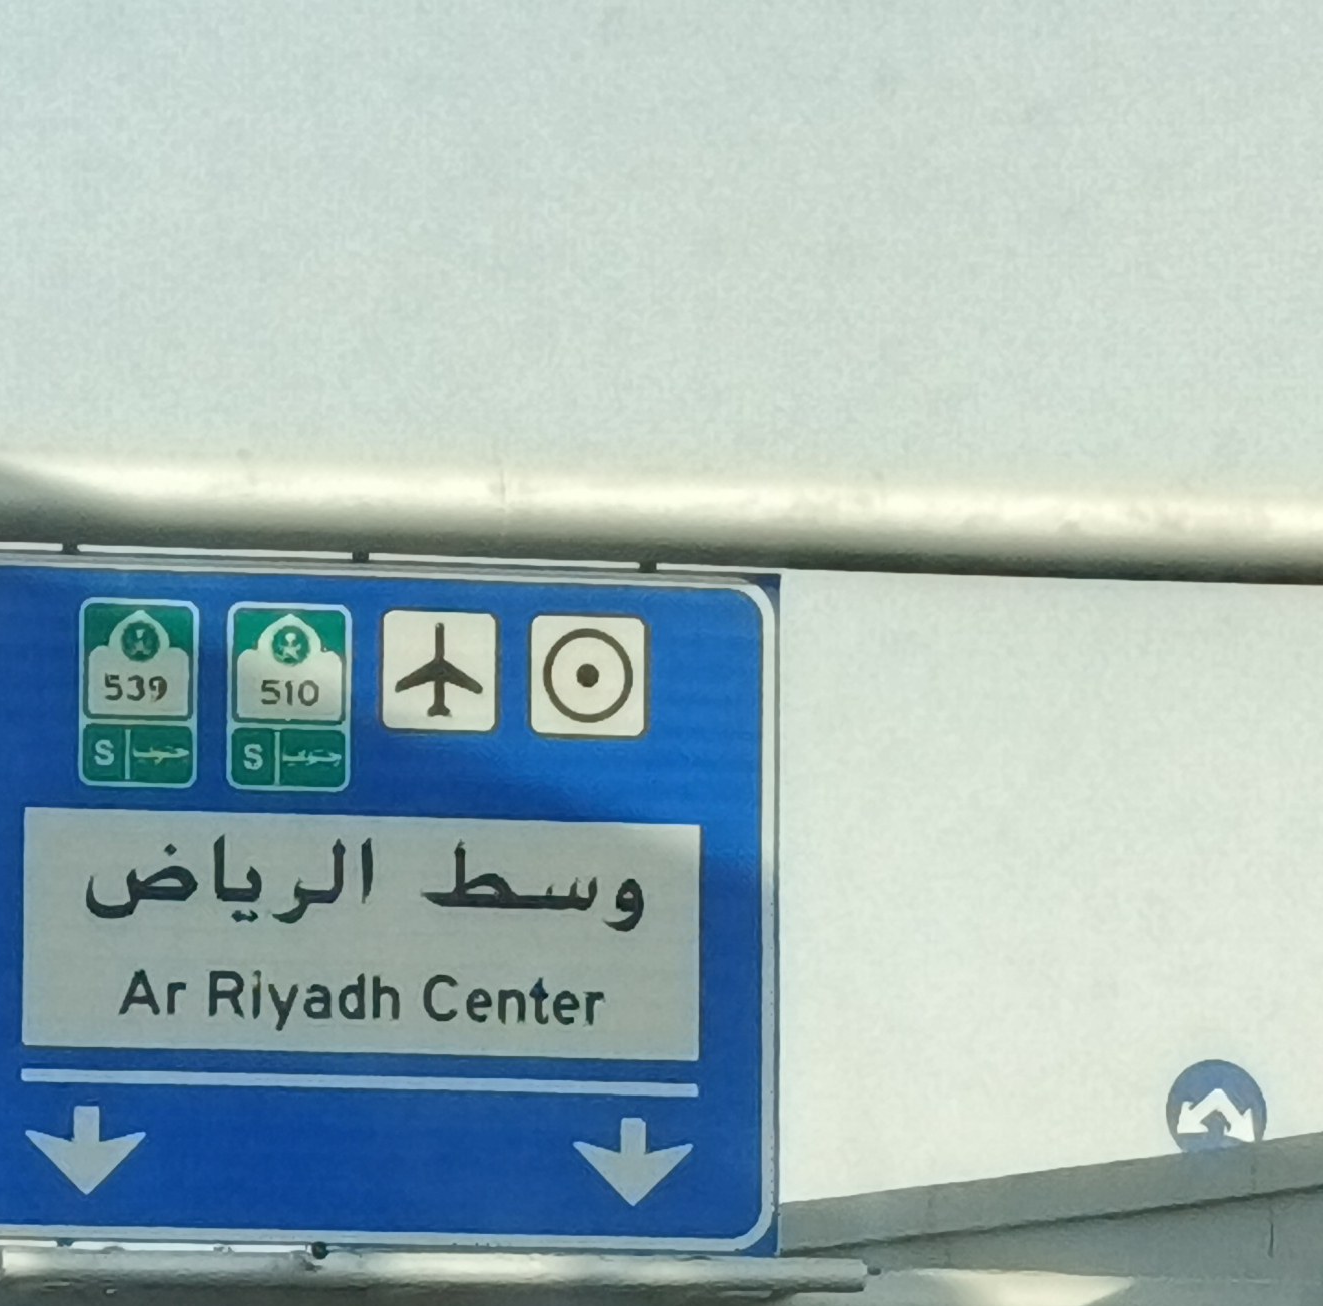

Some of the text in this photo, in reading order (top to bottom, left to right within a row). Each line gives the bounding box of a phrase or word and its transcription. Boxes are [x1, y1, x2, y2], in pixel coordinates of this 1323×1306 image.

[104, 673, 168, 703] 539
[260, 679, 319, 707] 510
[94, 739, 115, 766] S
[243, 743, 263, 770] S
[85, 834, 645, 933] وسط الرياض
[118, 969, 605, 1032] Ar Riyadh Center
